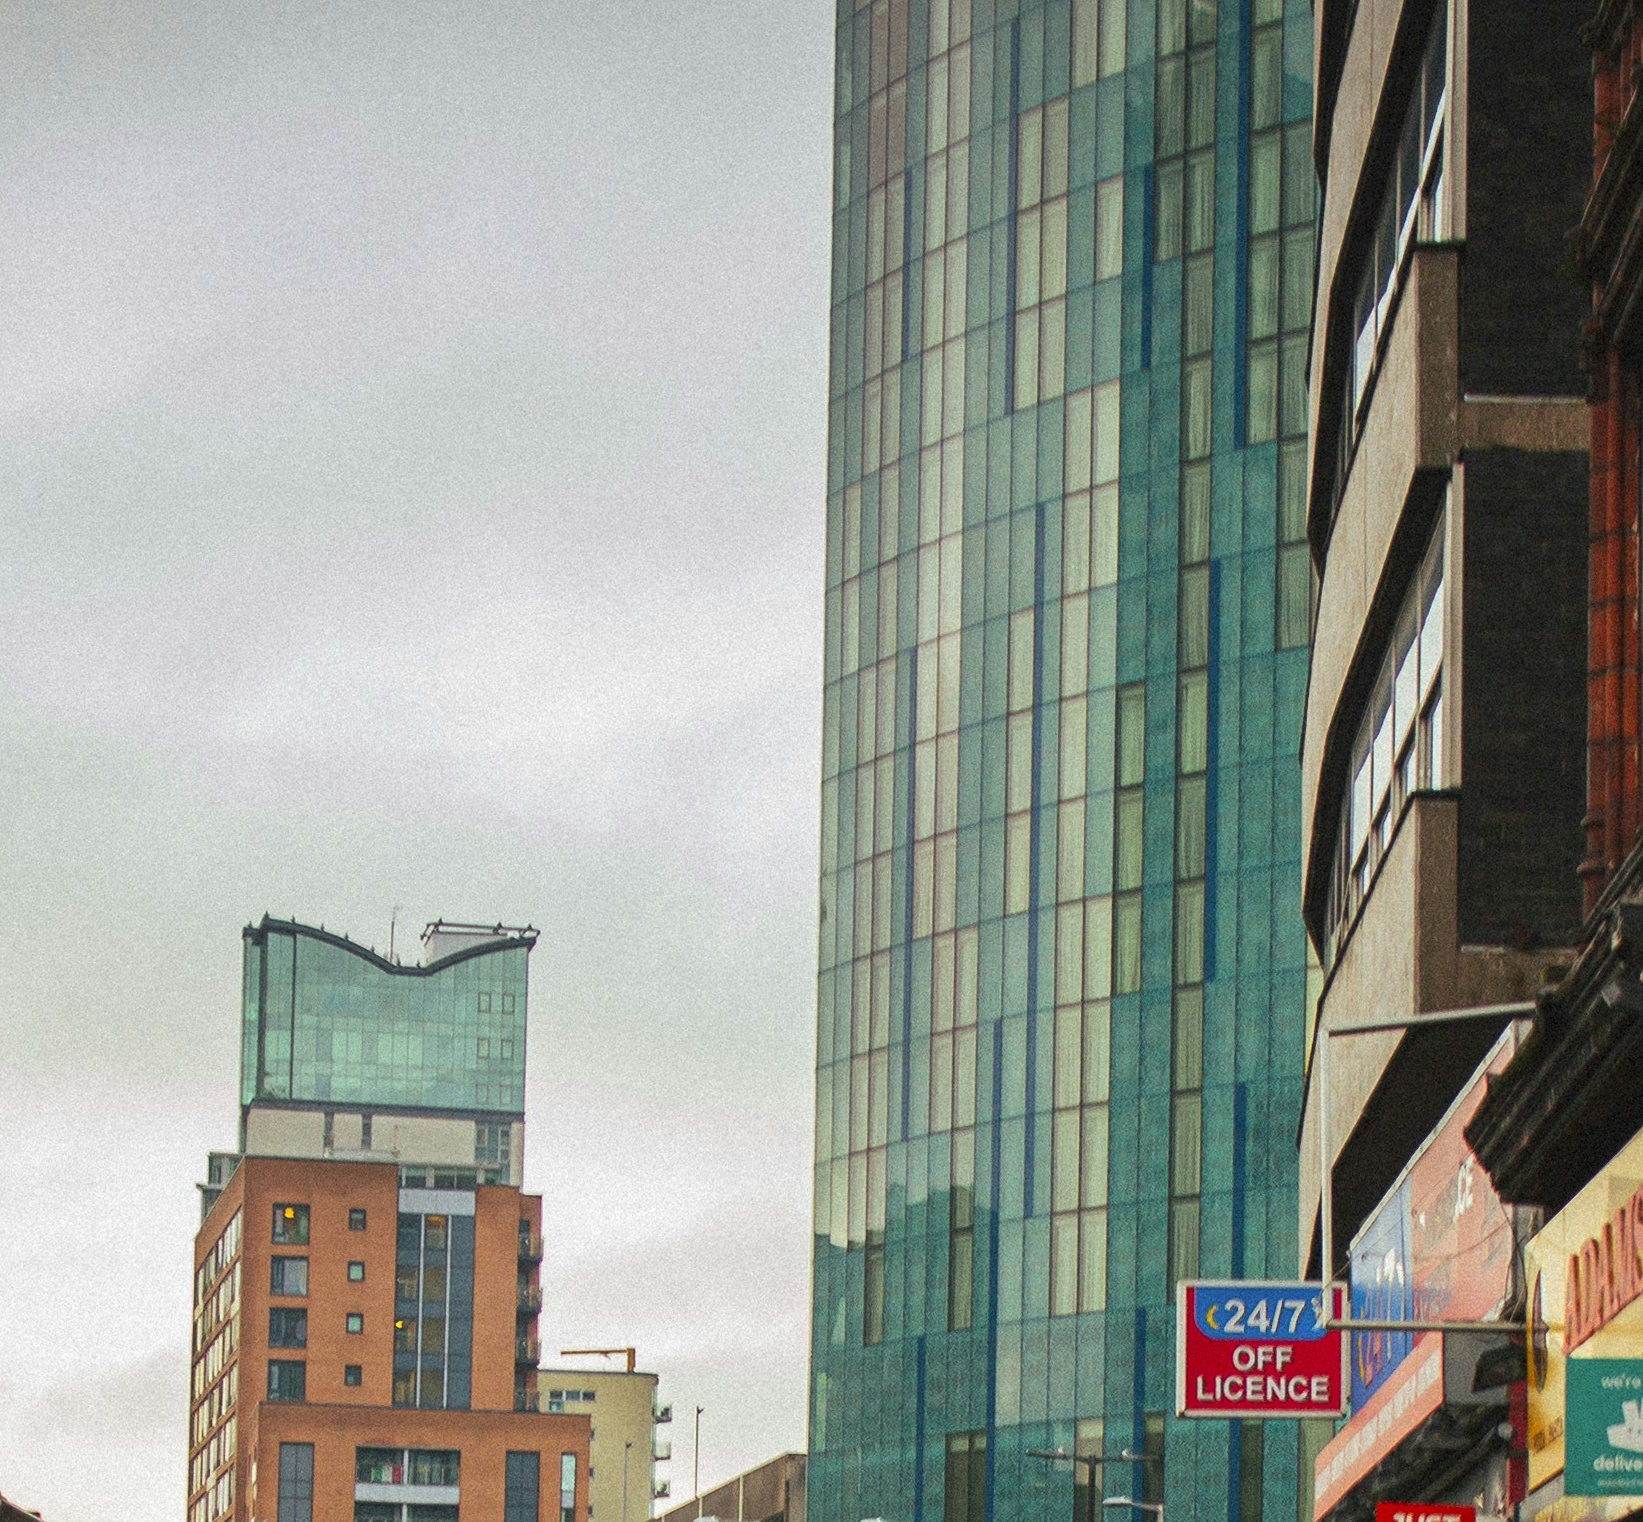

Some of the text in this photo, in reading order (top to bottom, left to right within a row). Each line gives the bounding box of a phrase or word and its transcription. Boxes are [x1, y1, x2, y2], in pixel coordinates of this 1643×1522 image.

[1223, 1298, 1307, 1334] 24/7
[1232, 1344, 1294, 1373] OFF
[1196, 1374, 1331, 1403] LICENCE
